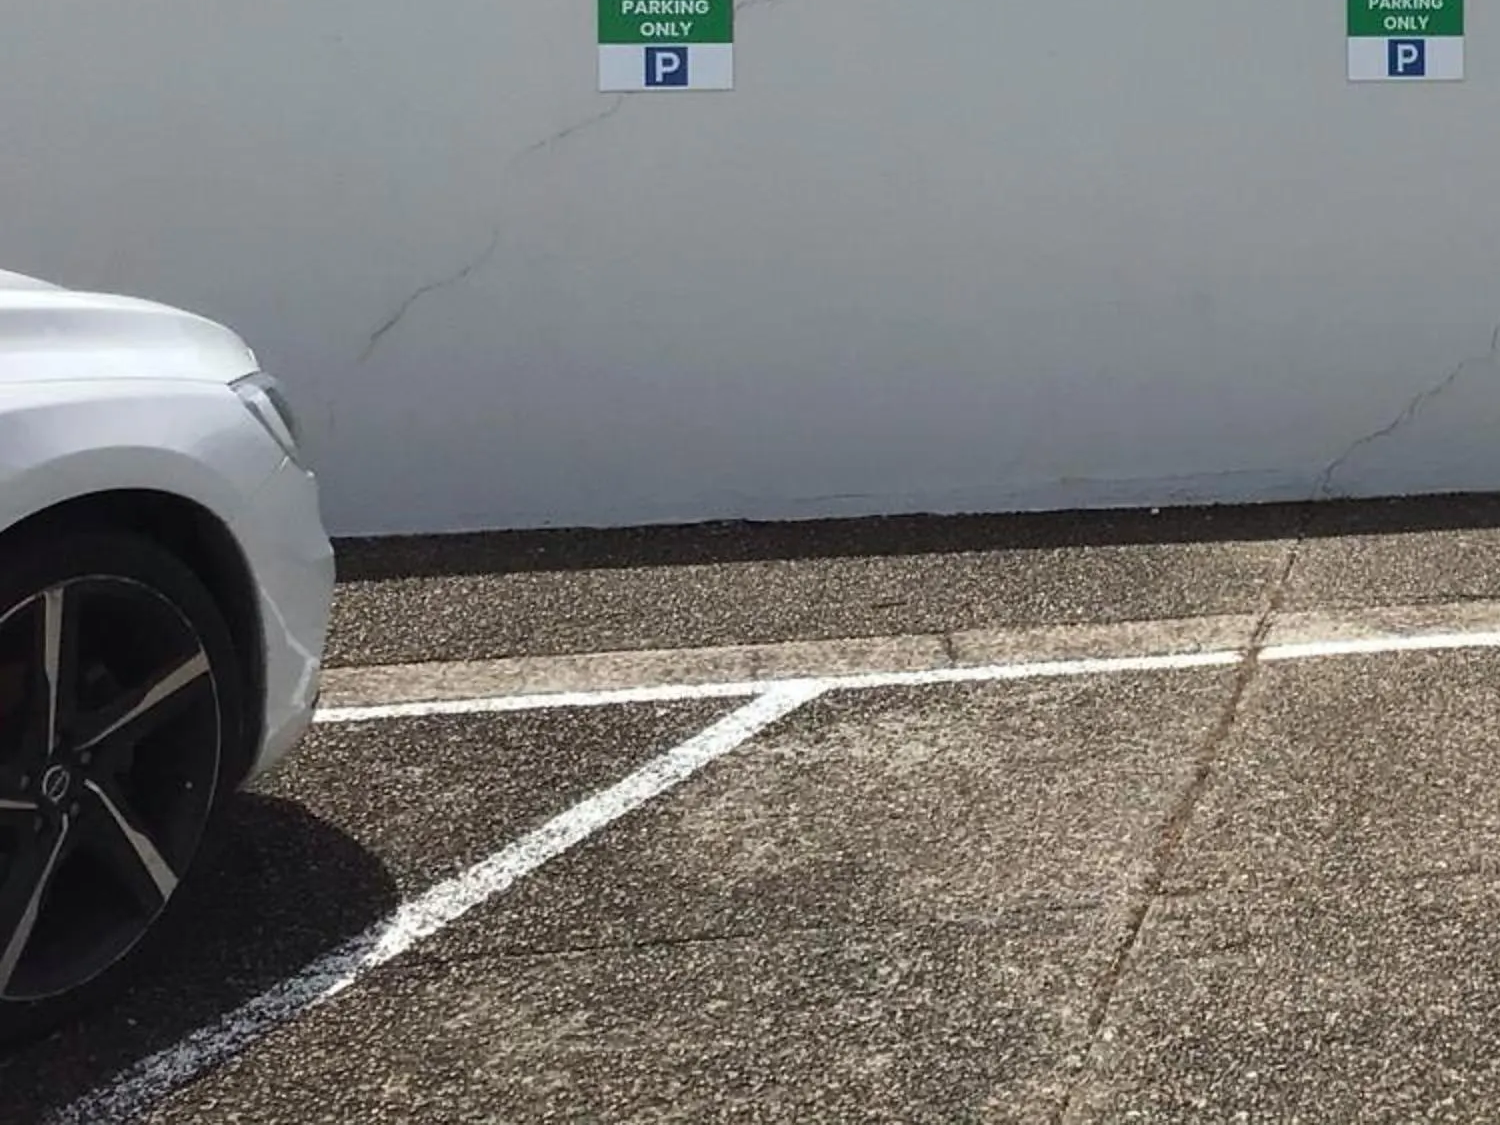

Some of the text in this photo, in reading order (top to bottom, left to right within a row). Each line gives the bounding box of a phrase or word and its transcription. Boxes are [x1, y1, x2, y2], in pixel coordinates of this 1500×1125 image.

[621, 0, 710, 15] PARKING
[640, 22, 693, 36] ONLY
[1383, 16, 1430, 30] ONLY
[1397, 43, 1418, 73] P
[655, 52, 680, 83] P
